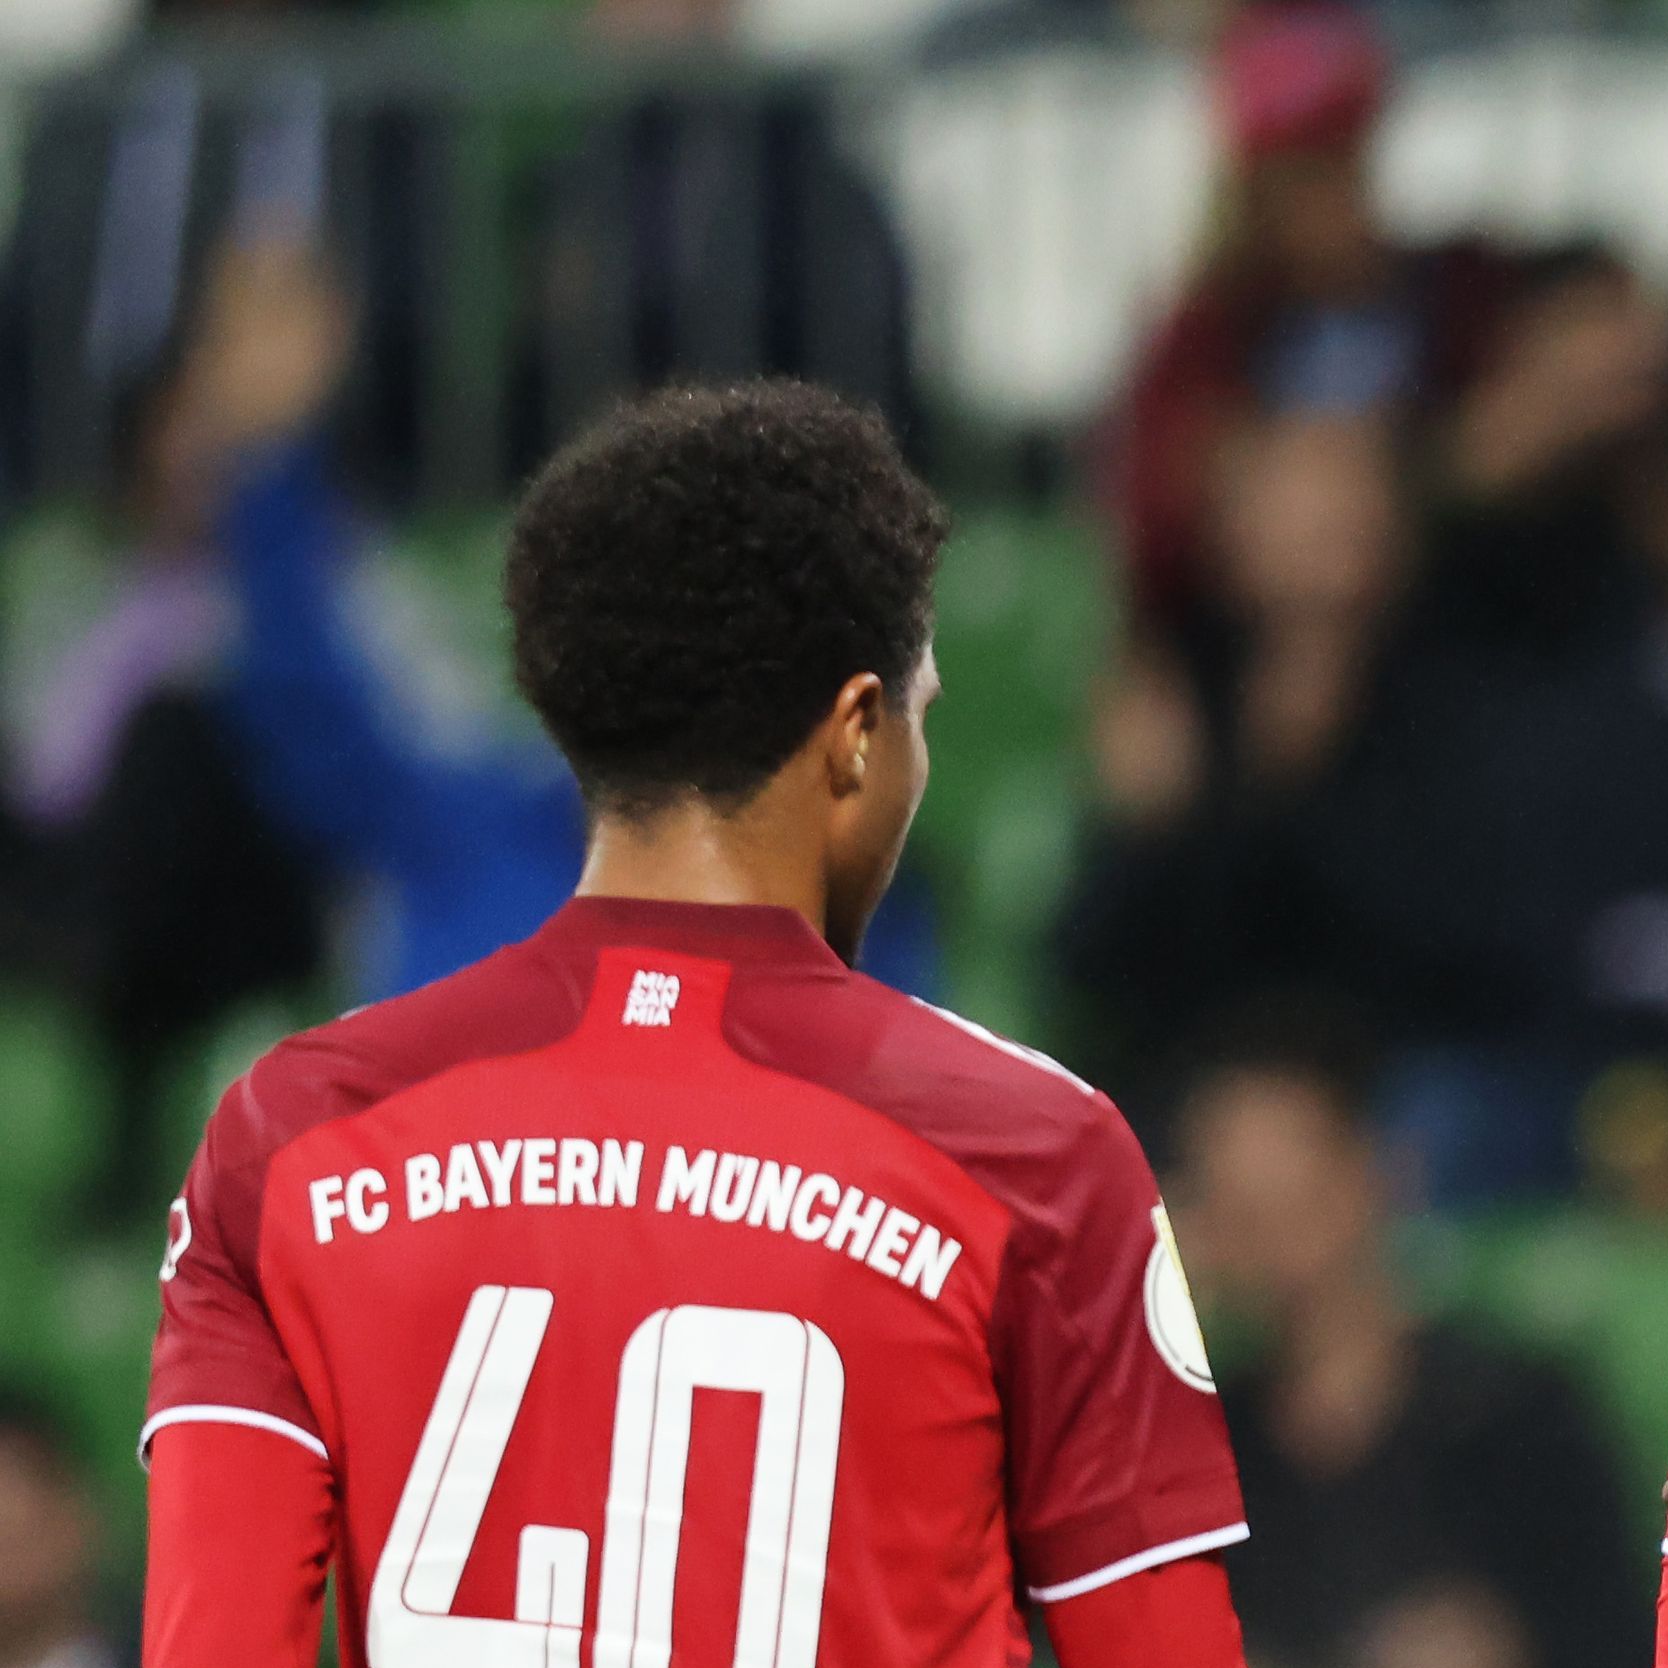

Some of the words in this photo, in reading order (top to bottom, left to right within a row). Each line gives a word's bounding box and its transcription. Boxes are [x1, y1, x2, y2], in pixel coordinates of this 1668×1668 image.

[308, 1167, 390, 1245] FC
[404, 1138, 645, 1223] BAYERN
[655, 1145, 963, 1300] MÜNCHEN
